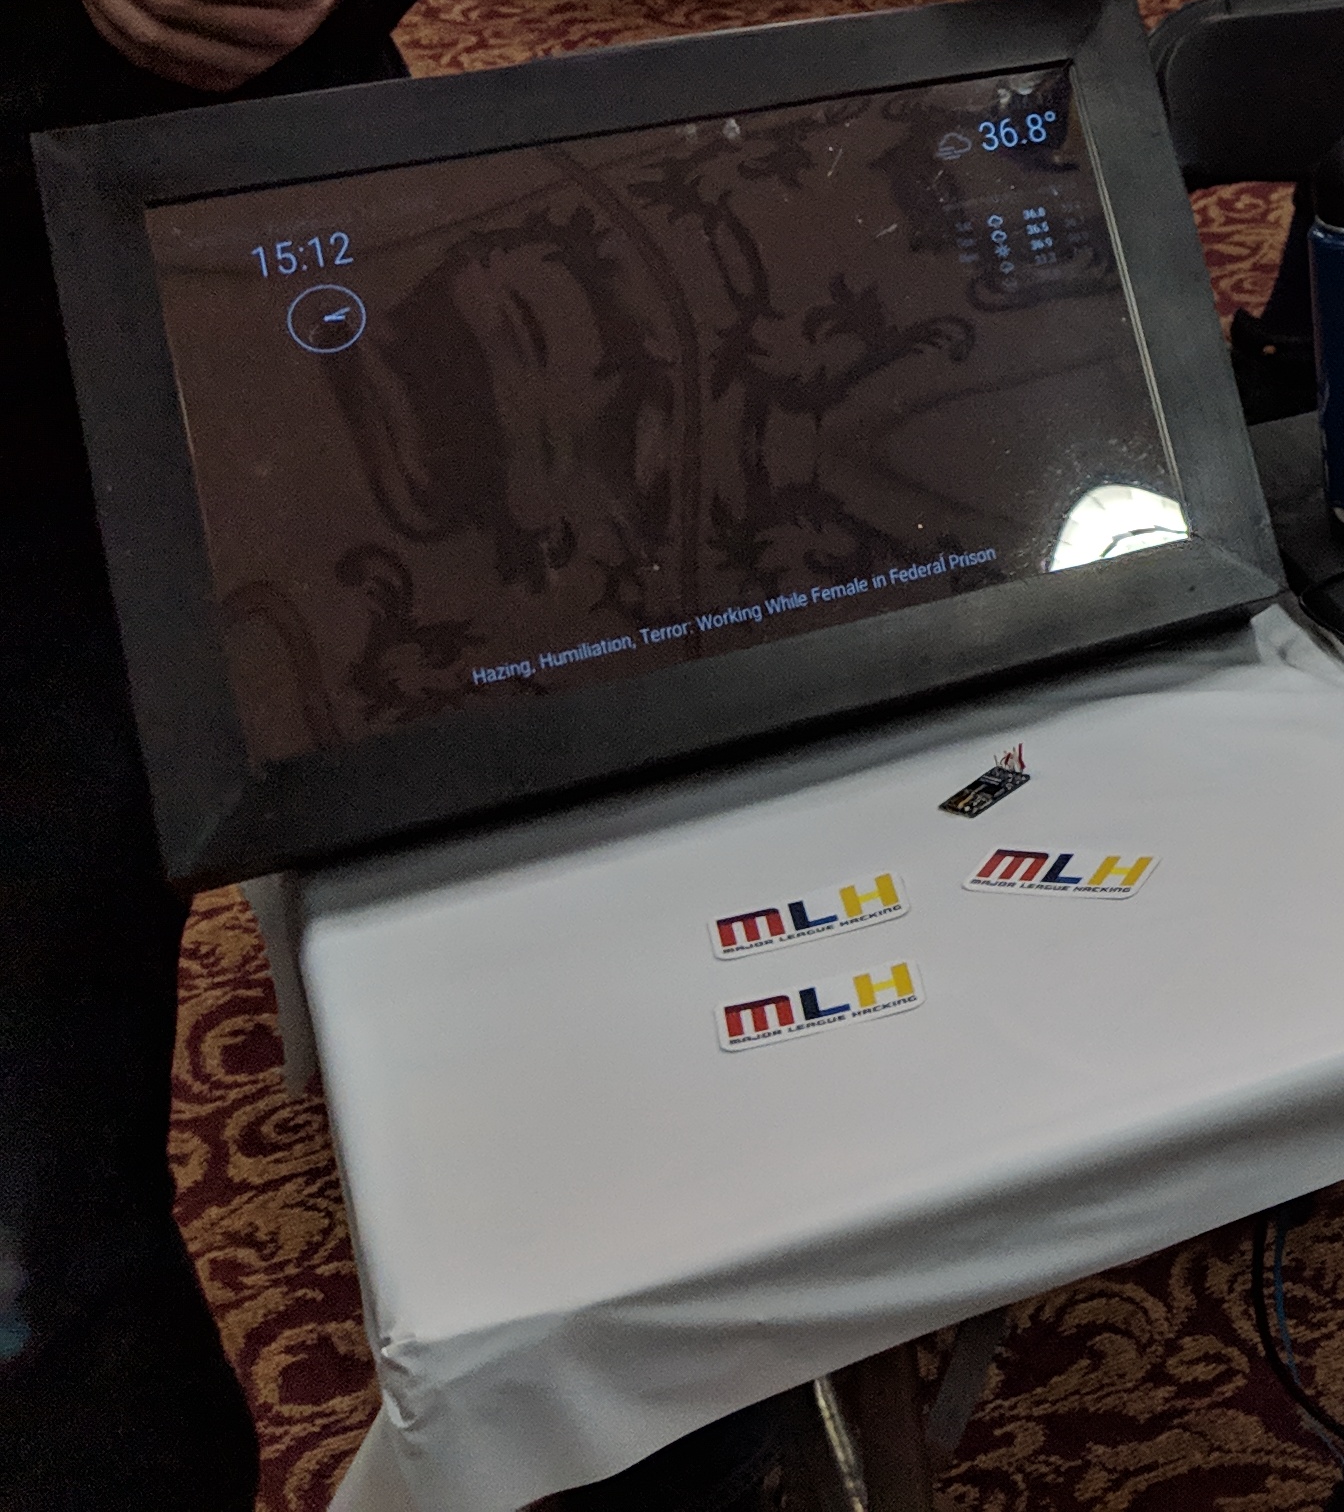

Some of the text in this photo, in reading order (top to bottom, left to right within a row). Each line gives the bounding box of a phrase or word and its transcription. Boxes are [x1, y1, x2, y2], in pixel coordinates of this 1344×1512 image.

[251, 231, 354, 278] 15:12
[538, 633, 637, 670] Humiliation,
[696, 604, 763, 633] Working
[764, 591, 809, 616] While
[811, 576, 869, 604] Female
[872, 574, 888, 590] in
[889, 553, 947, 586] Federal
[949, 546, 997, 571] Prison
[1019, 881, 1070, 893] LEAGUE
[1072, 885, 1131, 894] HACKING
[721, 903, 903, 954] MAJOR LEAGUE HACKING
[729, 993, 919, 1046] MAJOR LEAGUE HACKING
